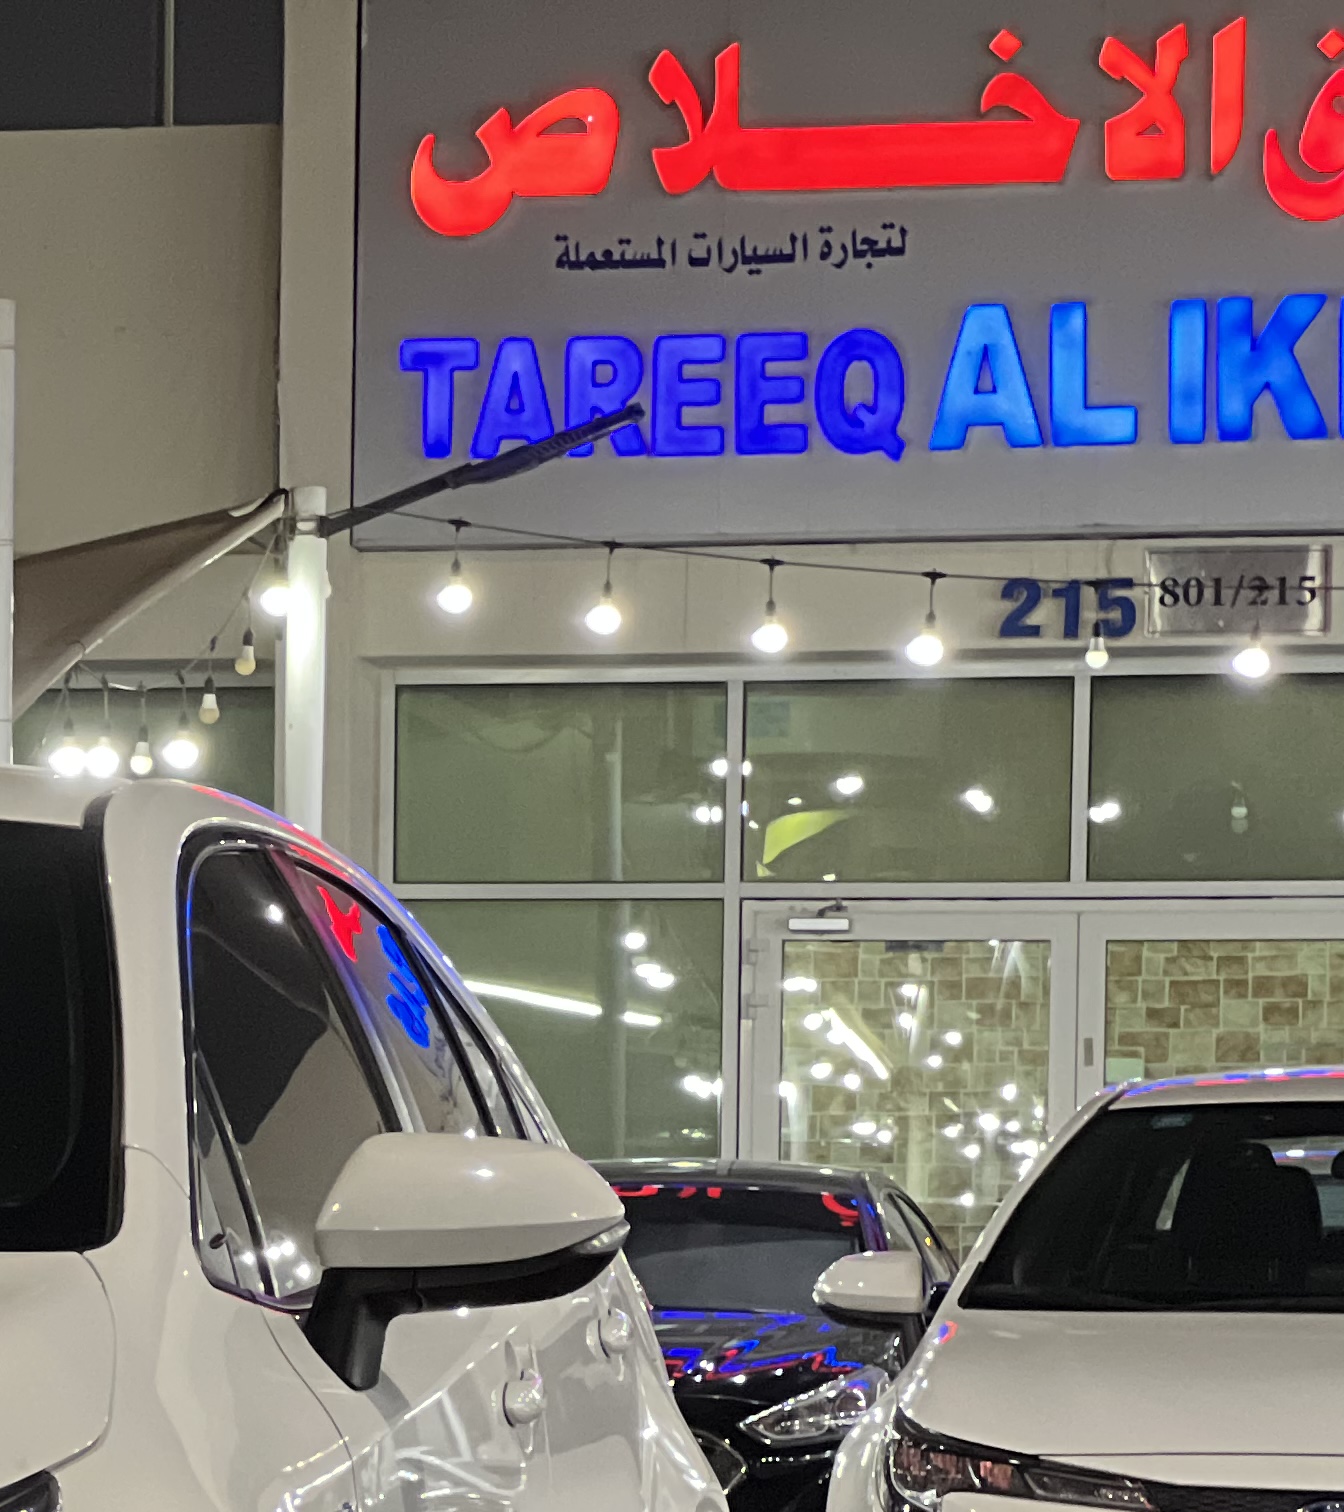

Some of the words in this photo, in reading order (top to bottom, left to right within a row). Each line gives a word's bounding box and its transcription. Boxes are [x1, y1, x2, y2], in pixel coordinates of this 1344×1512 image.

[554, 233, 677, 272] المستعملة
[688, 231, 809, 275] السيارات
[817, 221, 908, 271] لتجارة
[398, 328, 907, 462] TAREEQ
[929, 302, 1138, 451] AL
[1168, 293, 1344, 444] IK
[999, 577, 1137, 639] 215
[1158, 575, 1317, 608] 801/215
